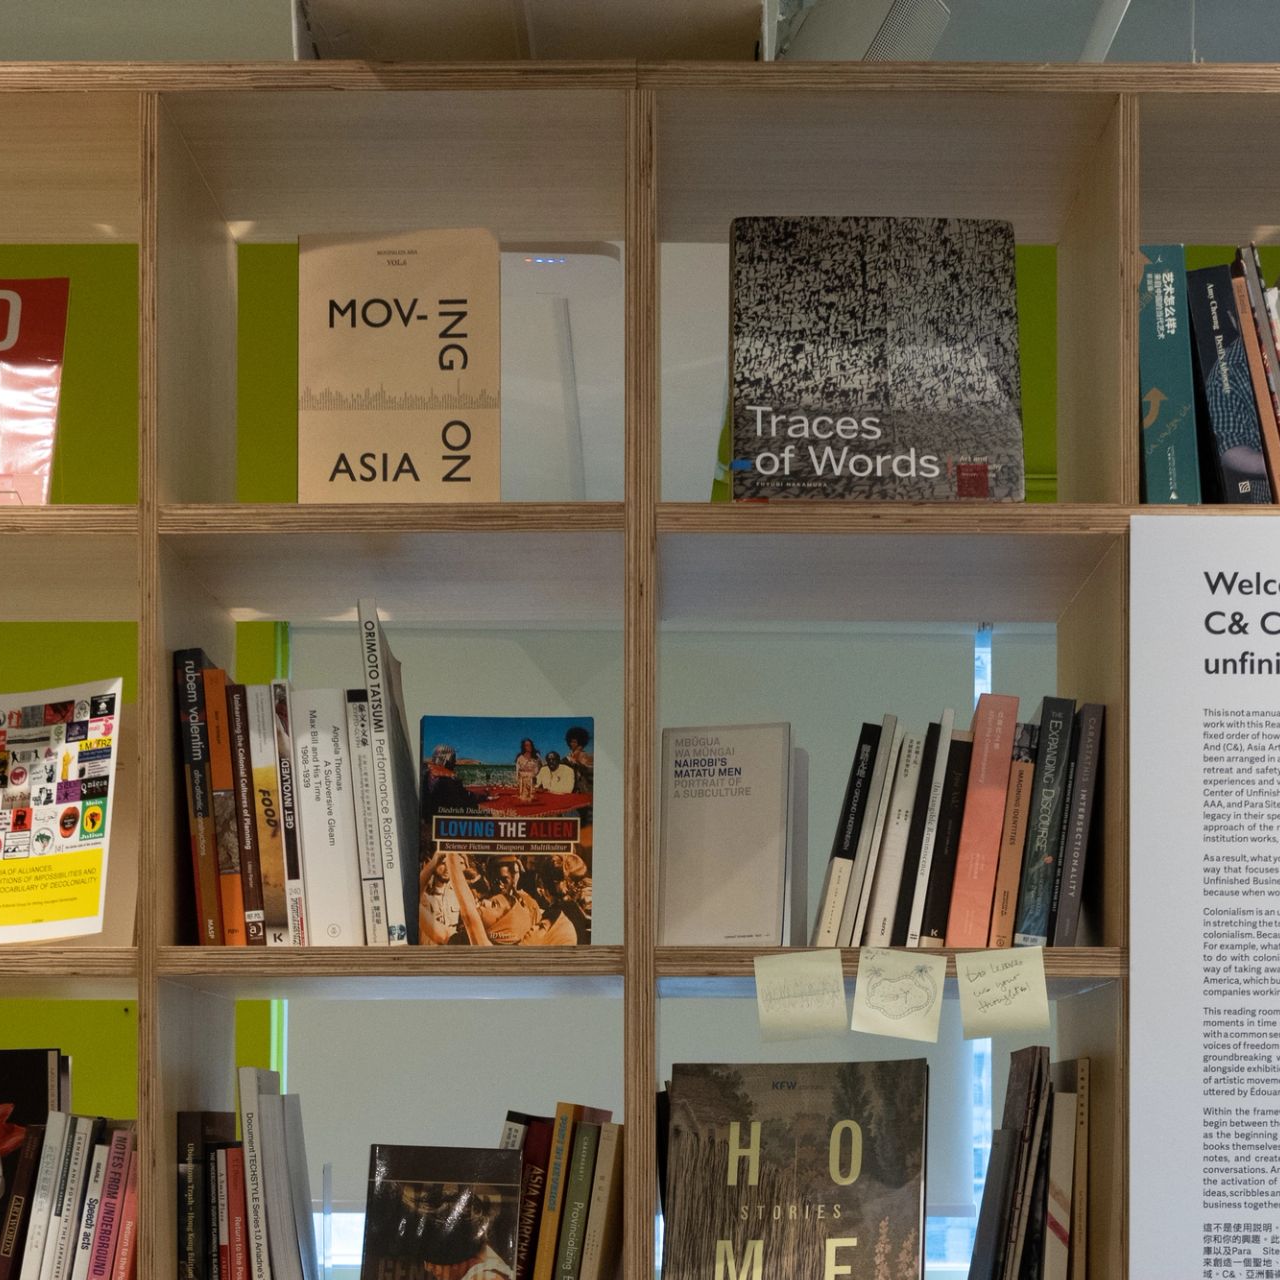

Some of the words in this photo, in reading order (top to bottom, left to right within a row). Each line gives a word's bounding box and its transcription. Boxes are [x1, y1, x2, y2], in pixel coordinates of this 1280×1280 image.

[1206, 283, 1215, 297] Amy
[328, 297, 428, 329] MOV-
[1209, 298, 1219, 330] Cheung
[438, 298, 468, 372] ING
[746, 405, 882, 440] Traces
[328, 452, 421, 483] ASIA
[442, 419, 472, 483] ON
[754, 445, 795, 478] of
[808, 446, 941, 479] Words
[1203, 610, 1250, 636] C&
[364, 621, 380, 680] ORIMOTO
[185, 660, 197, 703] rubem
[370, 683, 384, 733] TATSUMI
[189, 707, 202, 761] valentim
[332, 725, 340, 754] Angela
[1043, 719, 1063, 784] EXPANDING
[334, 756, 343, 791] Thomas
[375, 738, 391, 816] Performance
[674, 757, 727, 768] NAIROBI'S
[674, 768, 715, 778] MATATU
[718, 767, 741, 776] MEN
[281, 758, 293, 803] INVOLVED!
[324, 768, 333, 811] Subversive
[674, 778, 725, 788] PORTRAIT
[728, 777, 742, 786] OF
[674, 790, 680, 798] A
[683, 787, 752, 798] SUBCULTURE
[1012, 769, 1024, 808] IMAGINING
[285, 806, 294, 829] GET
[440, 819, 494, 837] LOVING
[497, 820, 527, 838] THE
[529, 819, 574, 838] ALIEN
[1010, 809, 1019, 846] IDENTITIES
[383, 817, 394, 869] Raisonne
[1068, 789, 1087, 898] INTERSECTIONALITY
[39, 882, 48, 890] OF
[246, 1112, 254, 1154] Document
[115, 1136, 128, 1166] NOTES
[110, 1169, 123, 1198] FROM
[248, 1156, 259, 1202] TECHSTYLE
[82, 1198, 98, 1229] Speech
[740, 1204, 842, 1221] STORIES
[81, 1230, 92, 1250] acts
[93, 1200, 116, 1277] UNDERGROUND
[560, 1201, 584, 1271] Provincializing
